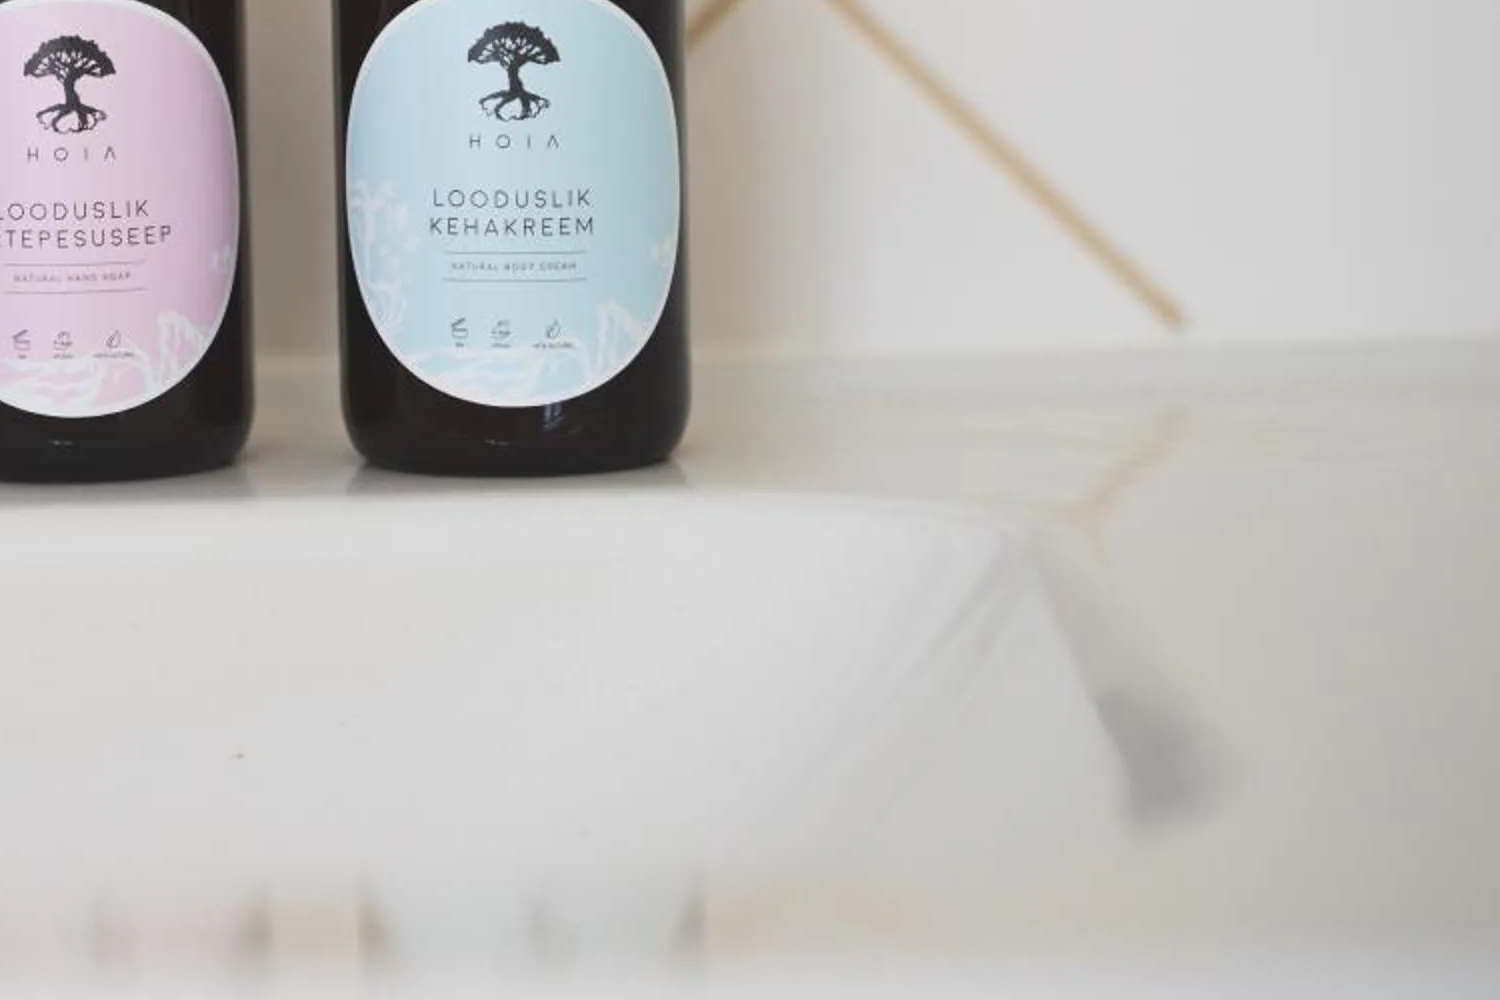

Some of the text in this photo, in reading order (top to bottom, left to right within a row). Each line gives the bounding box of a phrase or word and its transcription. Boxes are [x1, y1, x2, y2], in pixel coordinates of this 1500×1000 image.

[469, 133, 560, 149] HOIA
[26, 146, 118, 162] HOIA
[432, 188, 591, 209] LOODUSLIK
[429, 216, 594, 236] KEHAKREEM
